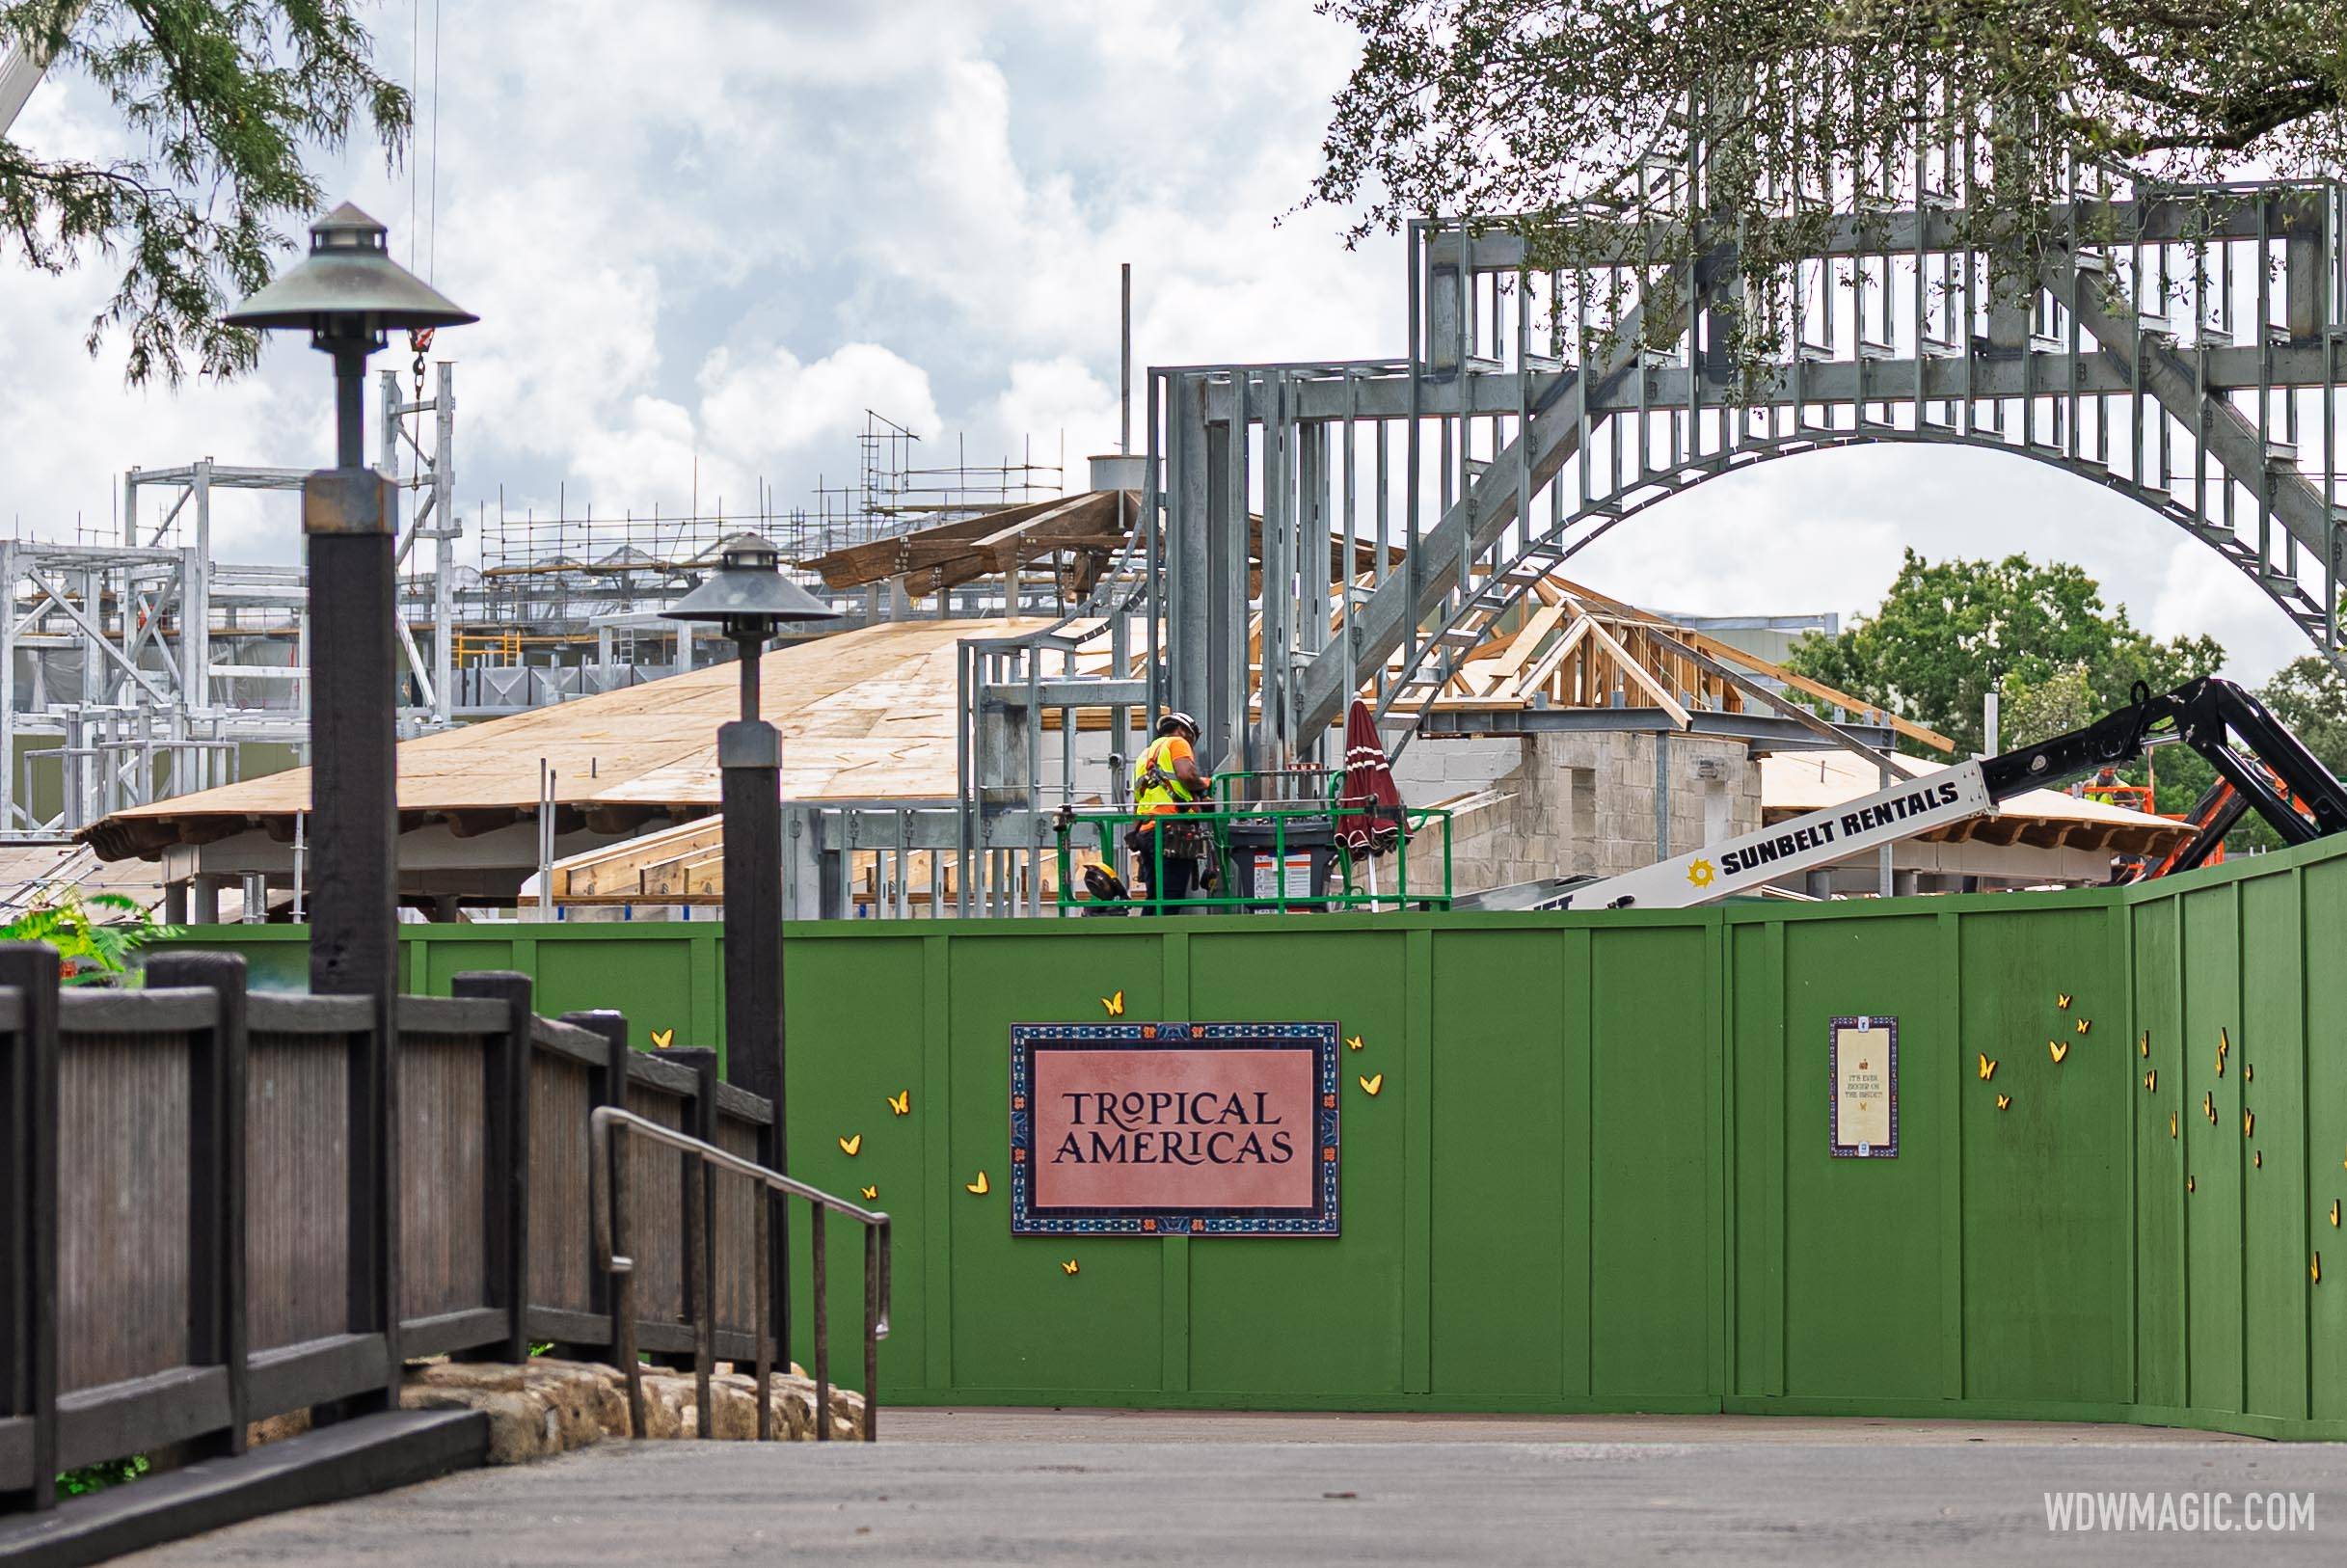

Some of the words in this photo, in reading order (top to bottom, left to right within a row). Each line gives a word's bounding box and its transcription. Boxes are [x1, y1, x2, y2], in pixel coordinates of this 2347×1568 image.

[1720, 821, 1836, 876] SUNBELT
[1840, 781, 1960, 837] RENTALS
[1062, 1092, 1281, 1132] TROPICAL
[1051, 1131, 1294, 1166] AMERICAS
